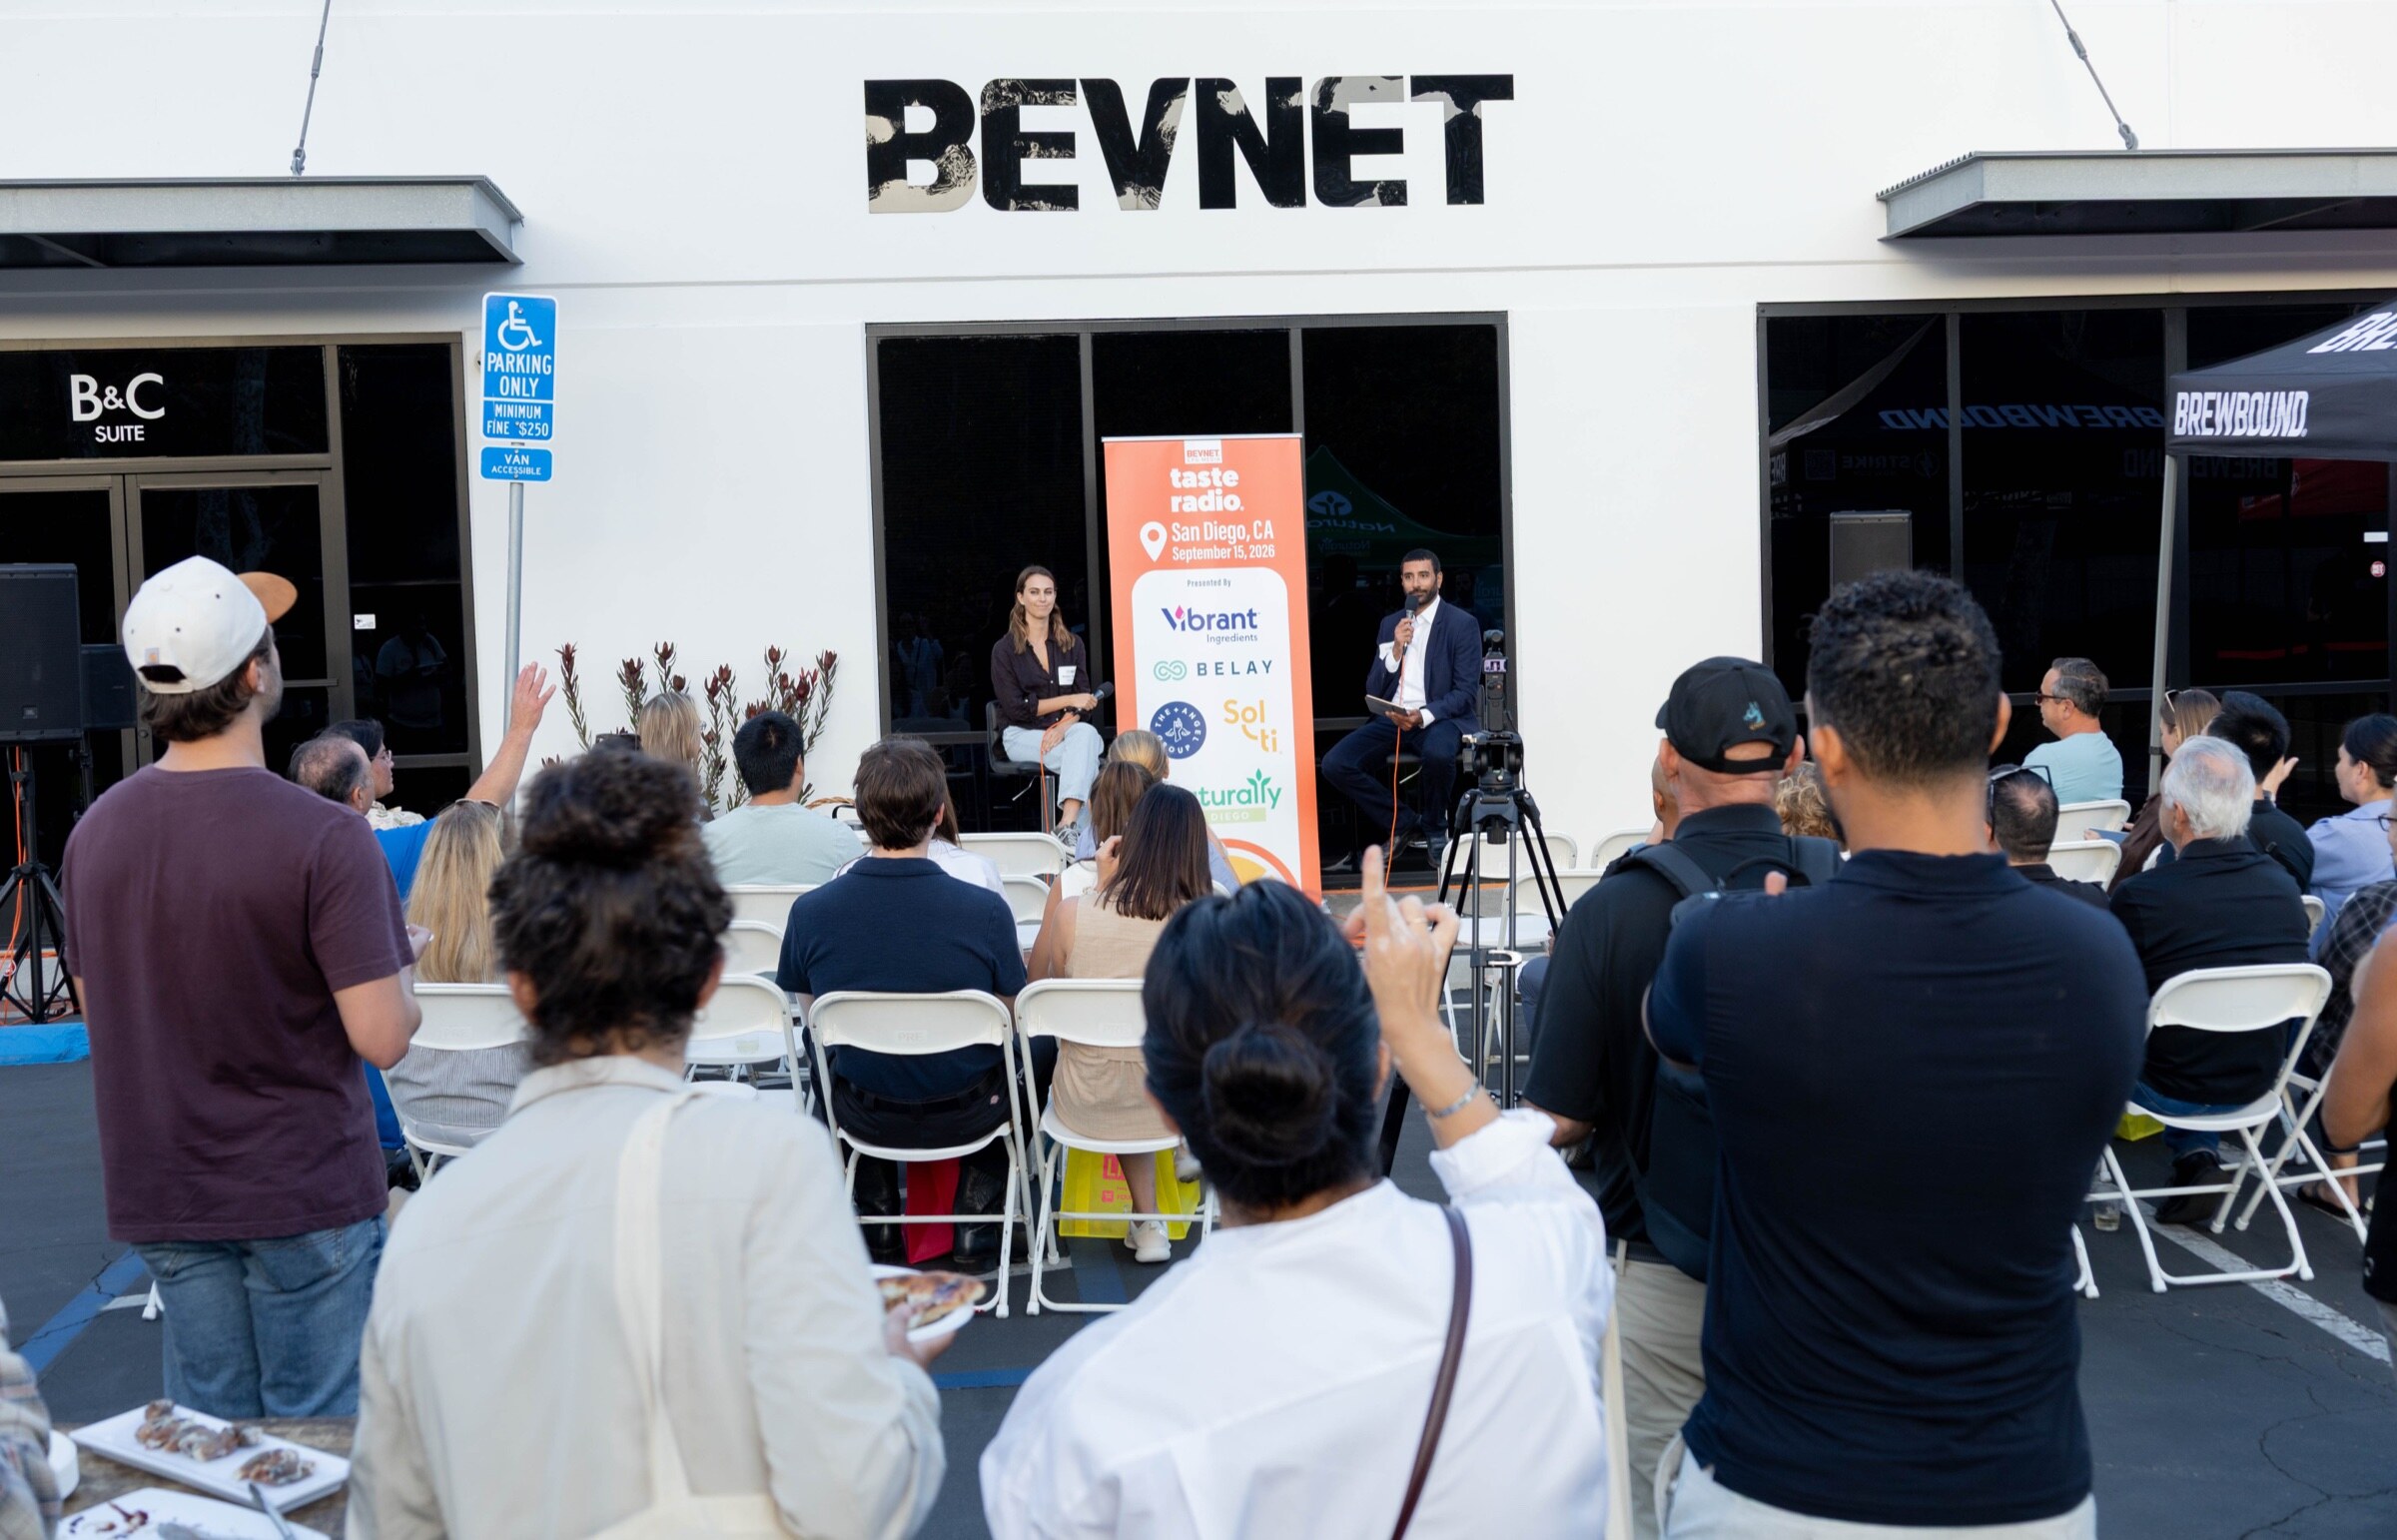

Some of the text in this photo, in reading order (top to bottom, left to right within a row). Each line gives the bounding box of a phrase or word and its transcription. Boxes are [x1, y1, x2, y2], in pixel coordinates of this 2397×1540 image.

[864, 74, 1514, 213] BEVNET
[487, 353, 552, 375] PARKING
[500, 376, 539, 397] ONLY
[71, 373, 165, 421] B&C
[494, 403, 541, 419] MINIMUM
[95, 425, 145, 442] SUITE
[486, 420, 549, 436] FINE $250
[504, 454, 529, 465] VAN
[491, 465, 542, 475] ACCESSIBLE
[1170, 467, 1239, 488] taste
[1172, 520, 1274, 545] San Diego, CA
[1172, 544, 1275, 563] September 15, 2026
[1187, 578, 1231, 587] Presented By
[1161, 605, 1258, 631] Vibrant
[1206, 633, 1258, 645] Ingredients
[1197, 660, 1272, 676] BELAY
[1223, 699, 1265, 724] Sol
[1155, 707, 1201, 742] THE ANGEL
[1260, 729, 1277, 752] ti
[1210, 812, 1250, 821] DIEGO
